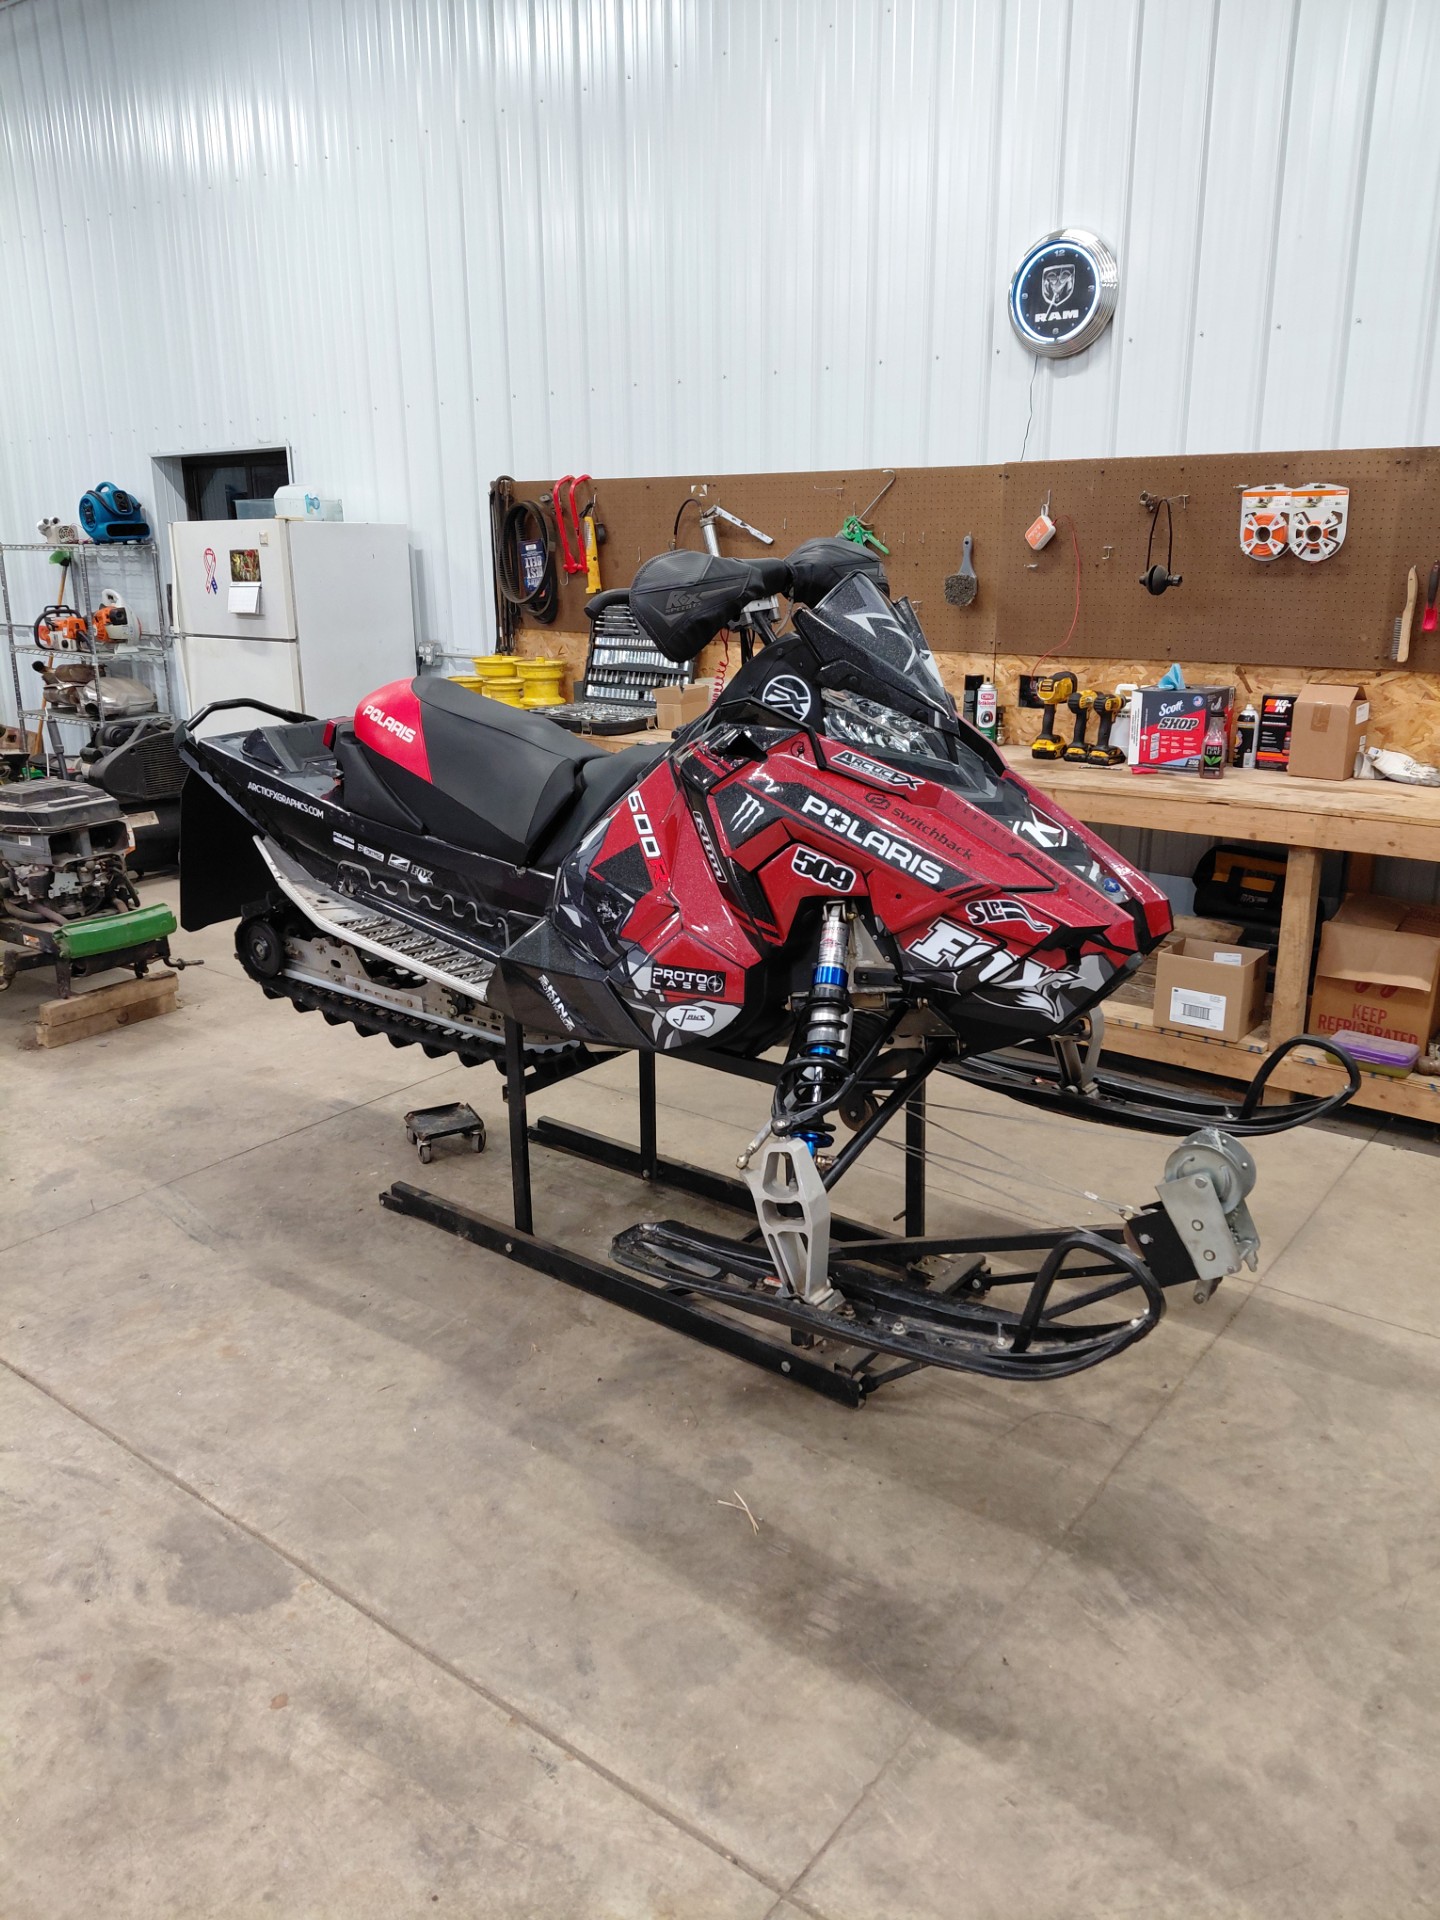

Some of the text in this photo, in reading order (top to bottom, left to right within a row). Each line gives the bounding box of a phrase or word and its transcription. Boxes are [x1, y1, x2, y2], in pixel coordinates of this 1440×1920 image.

[1054, 249, 1066, 257] 12
[1034, 309, 1080, 322] RAM
[1159, 700, 1184, 716] Scott
[362, 704, 417, 743] POLARIS
[1158, 717, 1199, 730] SHOP
[247, 781, 324, 820] ARCTICFXGRAPHICS.COM
[801, 795, 944, 885] POLARIS
[892, 807, 976, 861] switchback
[411, 864, 434, 883] FOX
[793, 847, 855, 892] 509
[906, 917, 1085, 991] FOX
[653, 967, 708, 984] PROTO
[539, 974, 576, 1030] SKINZ
[1352, 1003, 1388, 1024] KEEP
